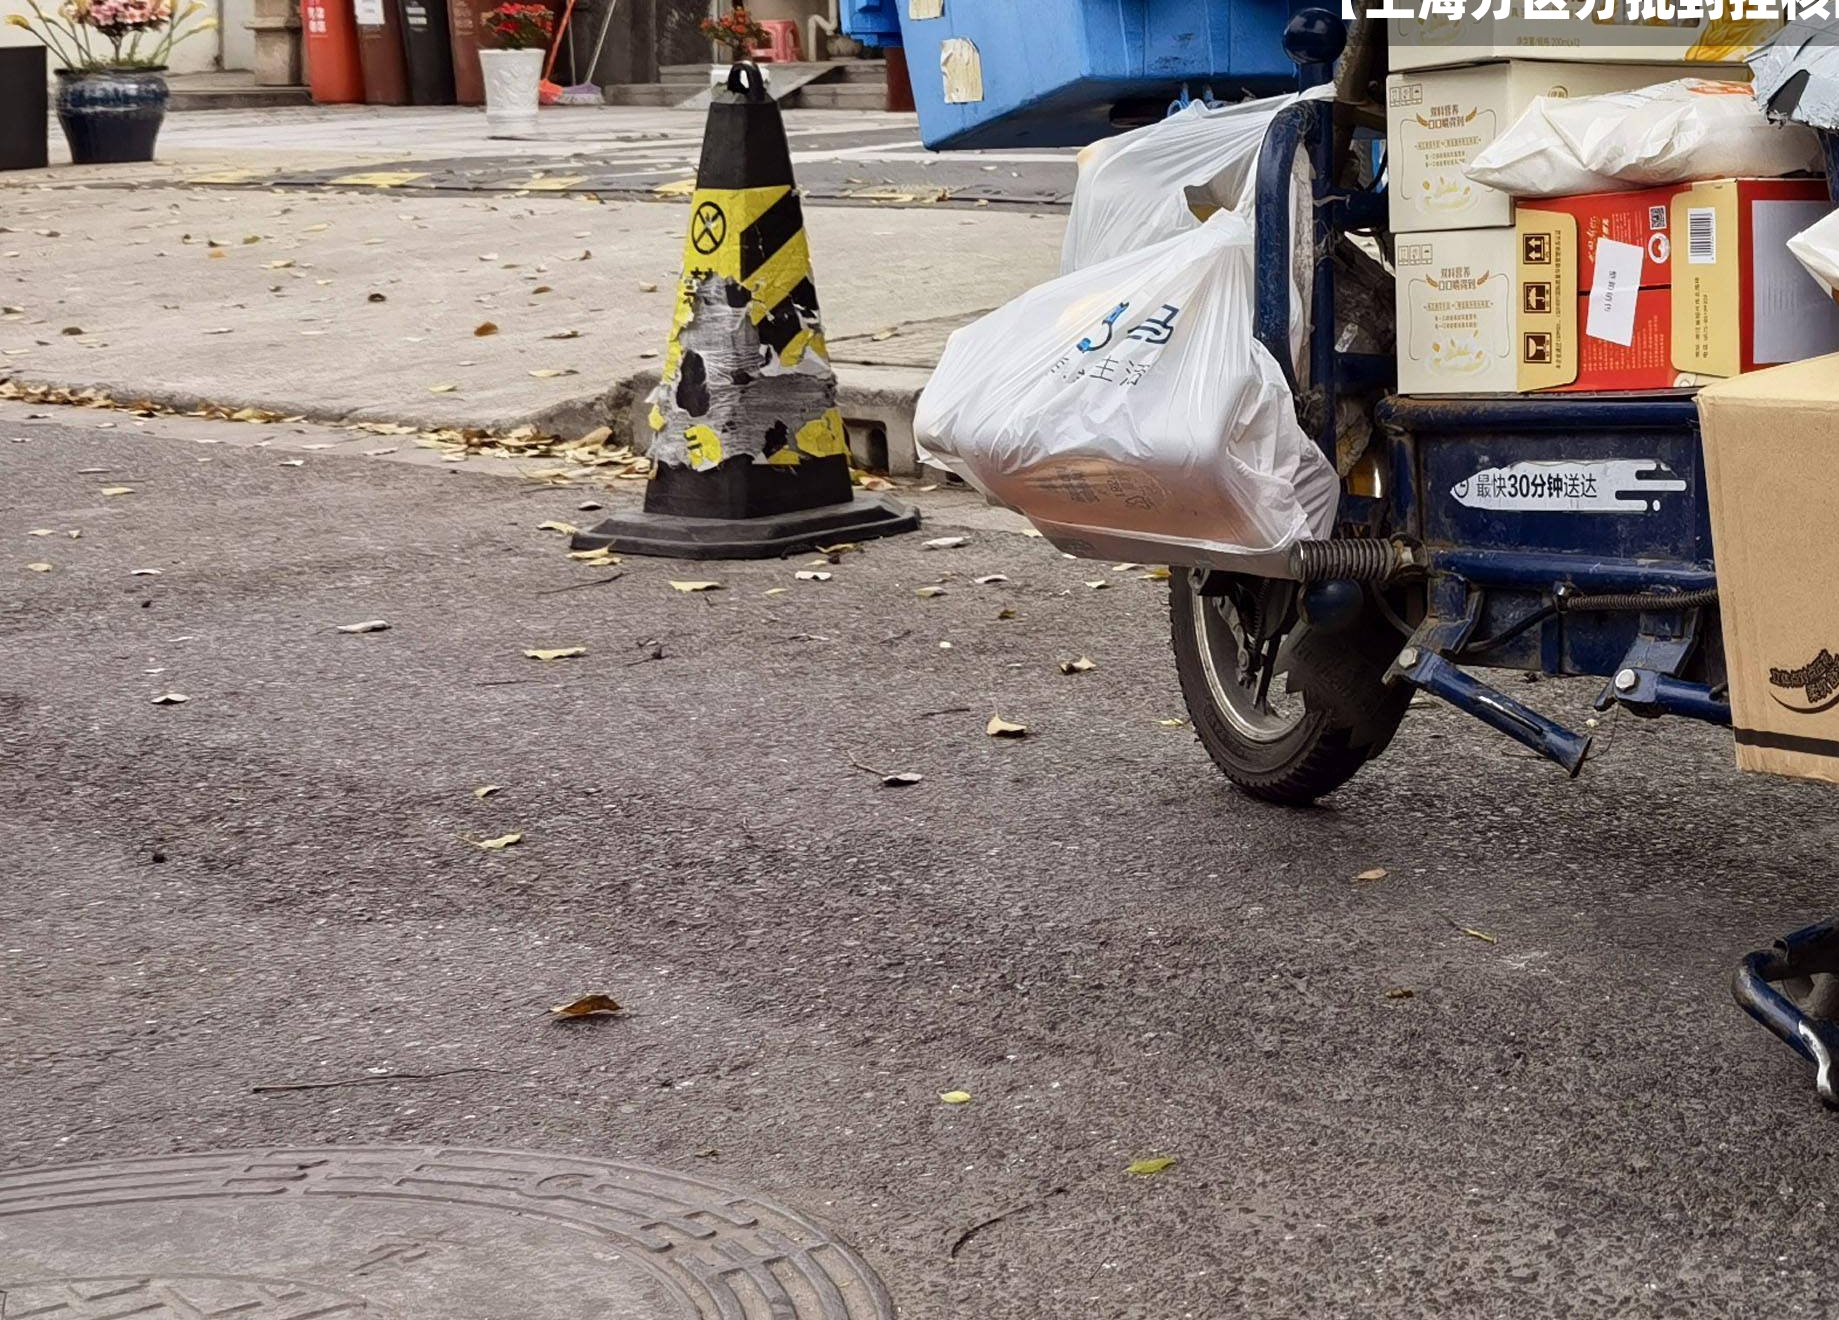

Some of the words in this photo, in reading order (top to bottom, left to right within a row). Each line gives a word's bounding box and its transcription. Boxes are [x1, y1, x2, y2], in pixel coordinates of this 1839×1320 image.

[1476, 474, 1597, 498] 最快30分钟送达
